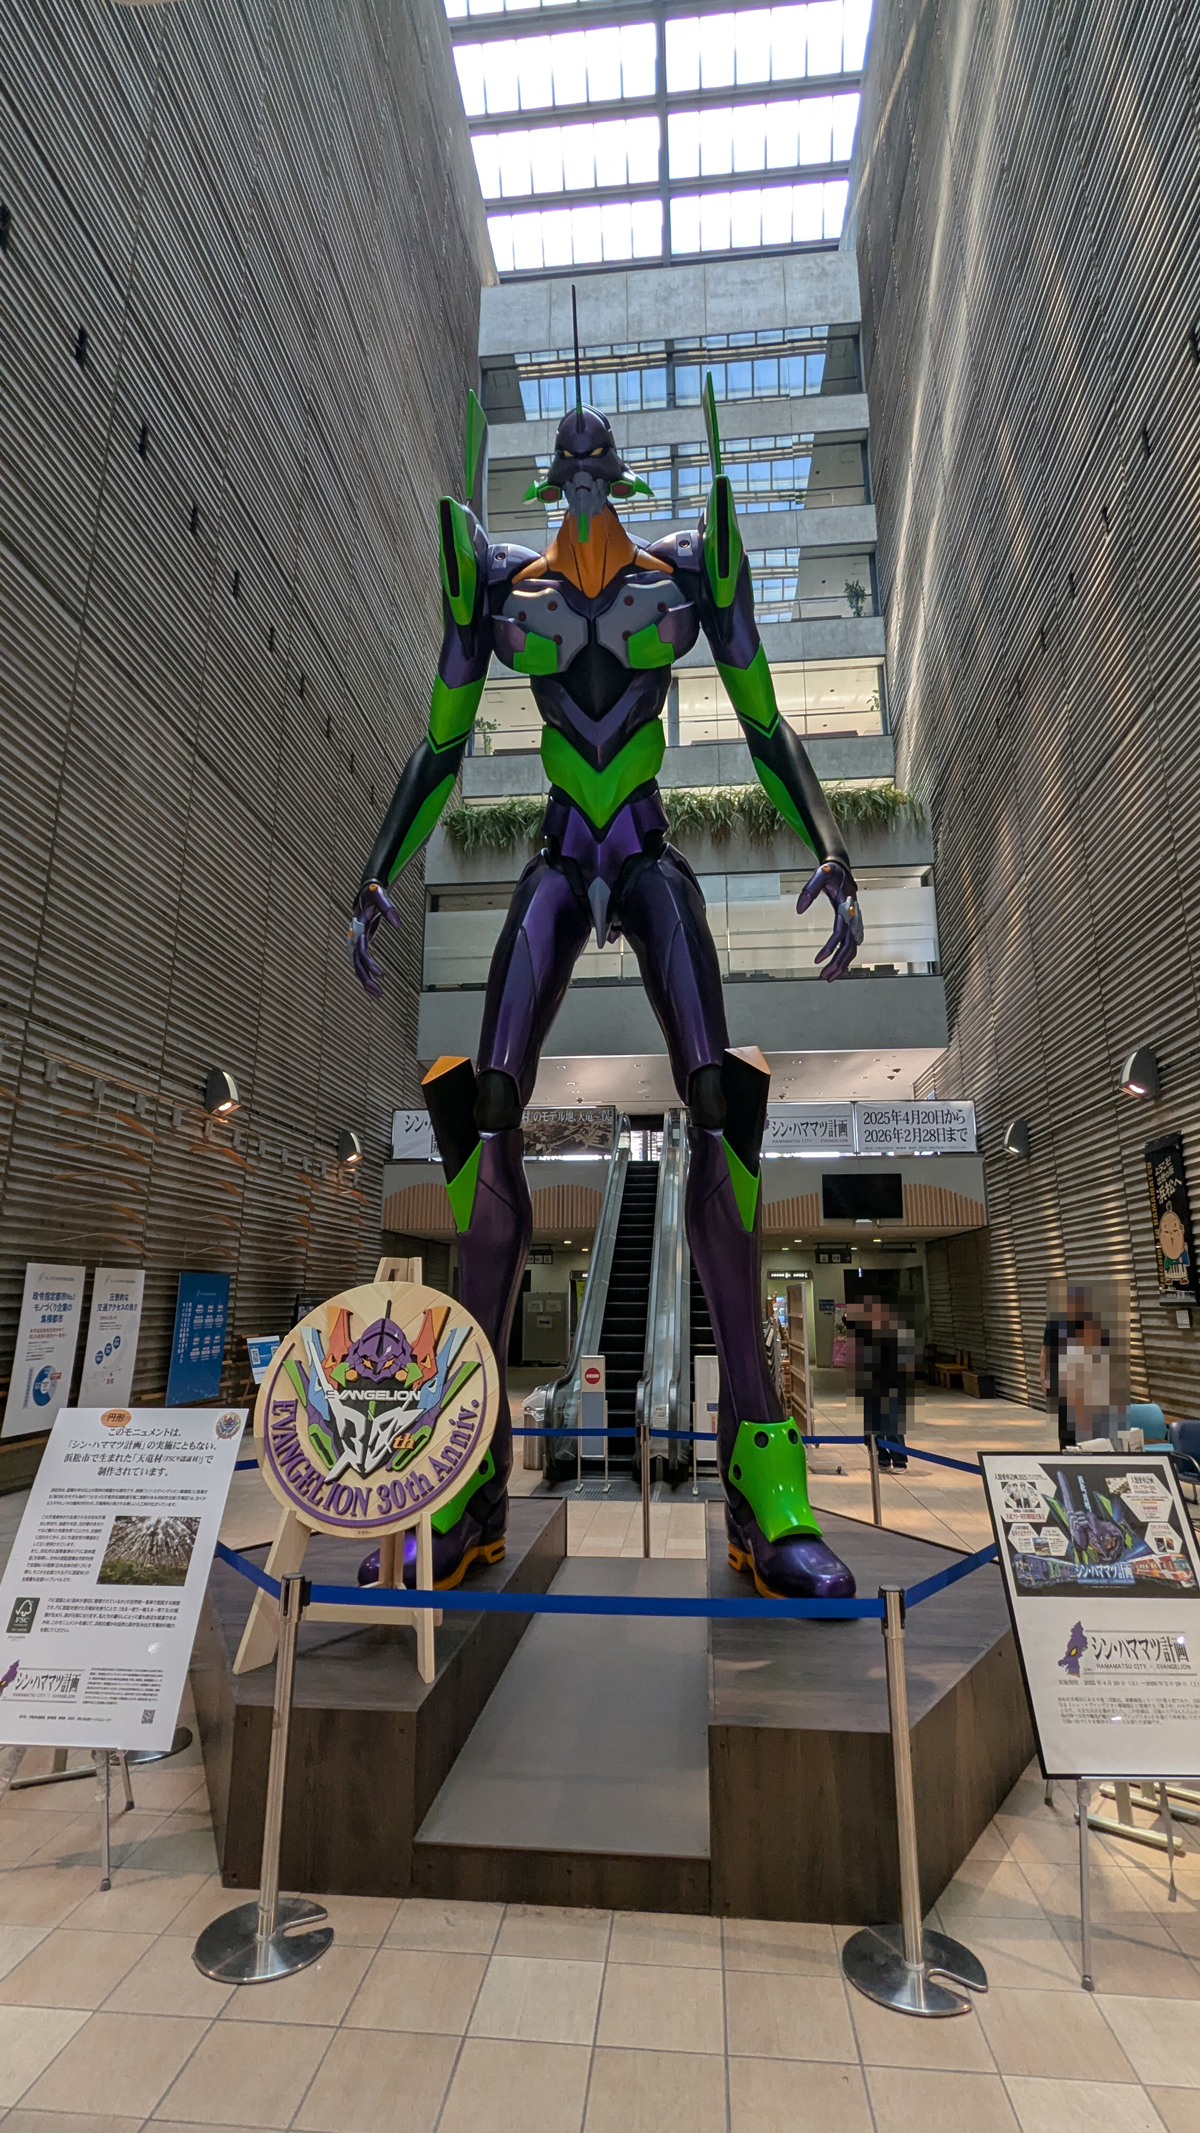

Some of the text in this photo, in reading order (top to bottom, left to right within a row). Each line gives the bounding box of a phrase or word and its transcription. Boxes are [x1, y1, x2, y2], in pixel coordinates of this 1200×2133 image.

[863, 1109, 966, 1125] 2025年4月20日から
[772, 1119, 848, 1138] シン・ハママツ計画
[864, 1127, 968, 1143] 2026年2月28日まで
[1155, 1155, 1172, 1176] ようこそ
[1146, 1161, 1159, 1226] HAMAMATSU
[1156, 1178, 1182, 1204] 浜松へ
[109, 1293, 129, 1302] 圧倒的な
[33, 1302, 73, 1312] モノづくり企業の
[96, 1303, 138, 1312] 交通アクセスの良さ
[326, 1389, 421, 1401] EVANGELION
[106, 1412, 126, 1422] 円形
[107, 1428, 182, 1437] このモニュメントは、
[67, 1440, 217, 1450] 「シン・ハママツ計画」の実施にともない、
[271, 1398, 480, 1518] EVANGELION 30th Anniv.
[97, 1467, 169, 1477] 制作されています。
[1074, 1562, 1134, 1579] シン・ハママツ計画
[15, 1616, 30, 1624] FSC
[1091, 1636, 1190, 1663] シン・ハママツ計画
[15, 1672, 82, 1693] シン・ハママツ計画
